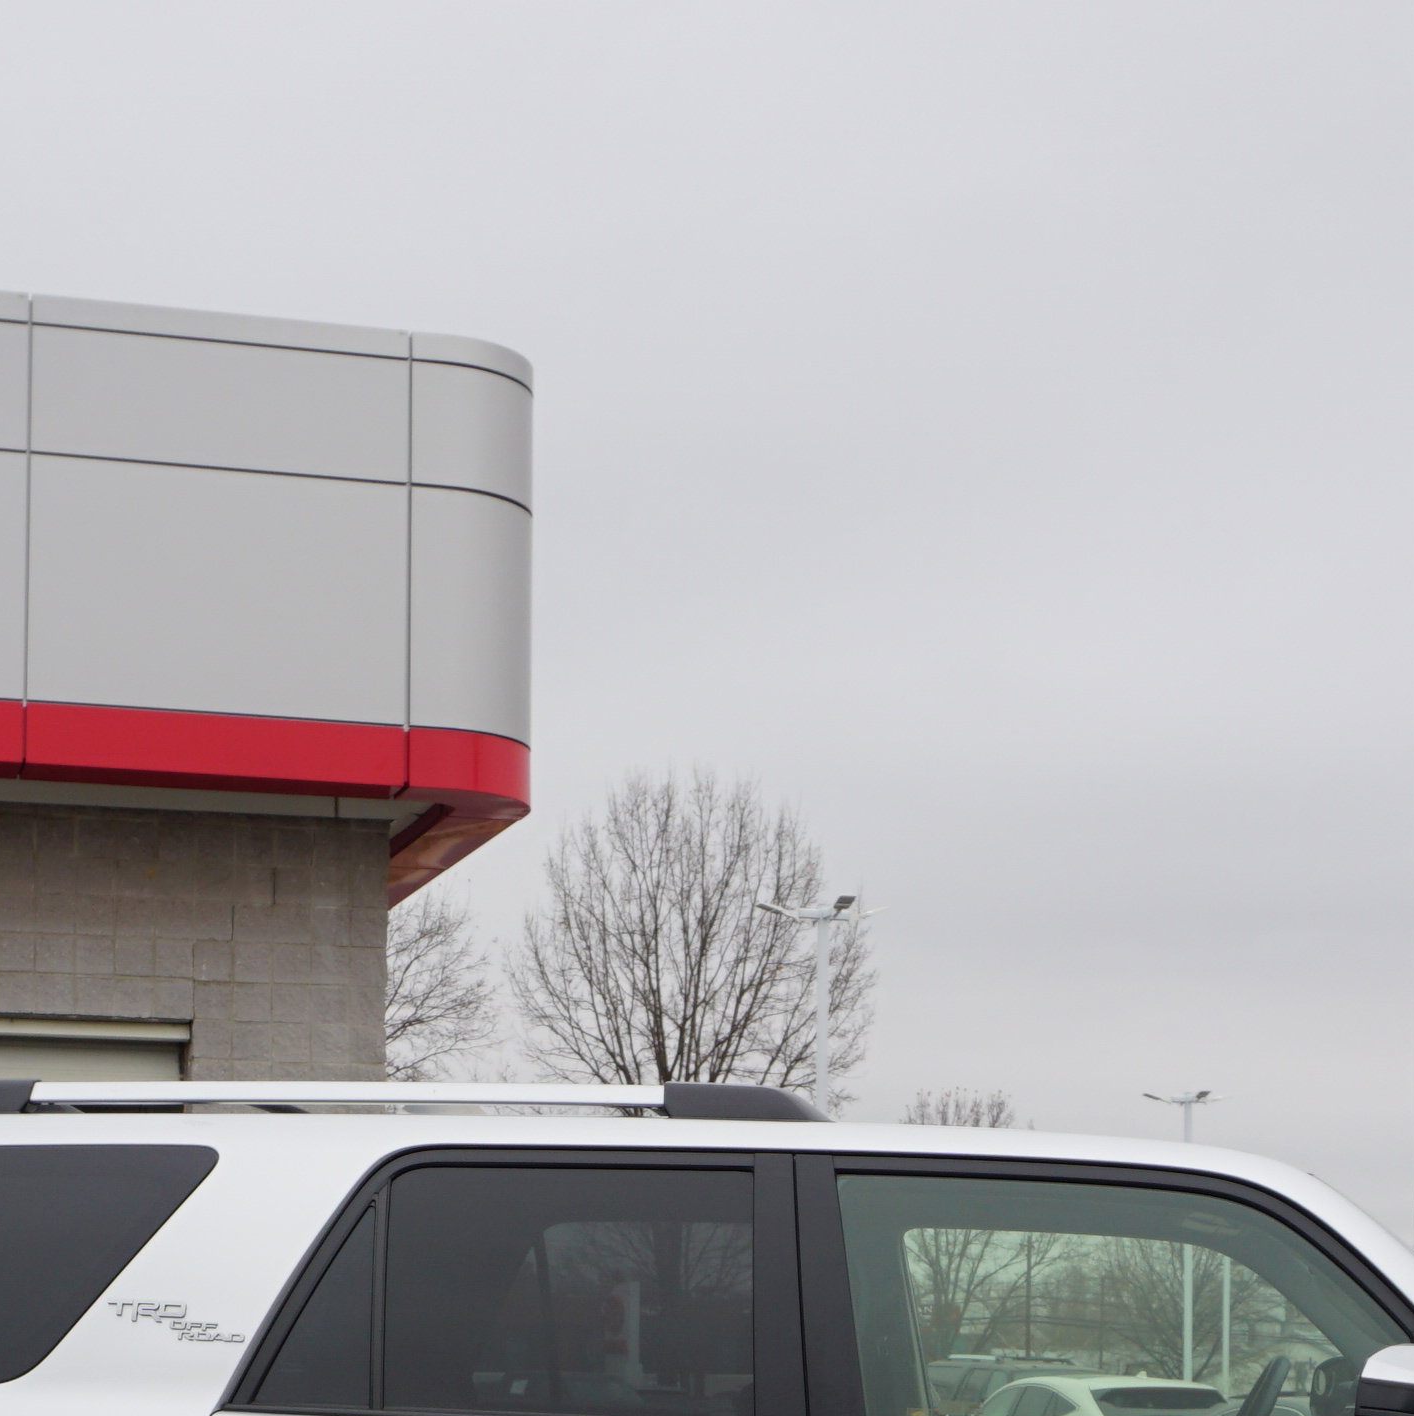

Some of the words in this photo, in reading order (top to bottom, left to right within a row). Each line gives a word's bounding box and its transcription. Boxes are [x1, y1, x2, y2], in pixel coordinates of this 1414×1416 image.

[107, 1301, 188, 1323] TRD
[169, 1319, 219, 1332] OFF
[178, 1331, 246, 1343] ROAD
